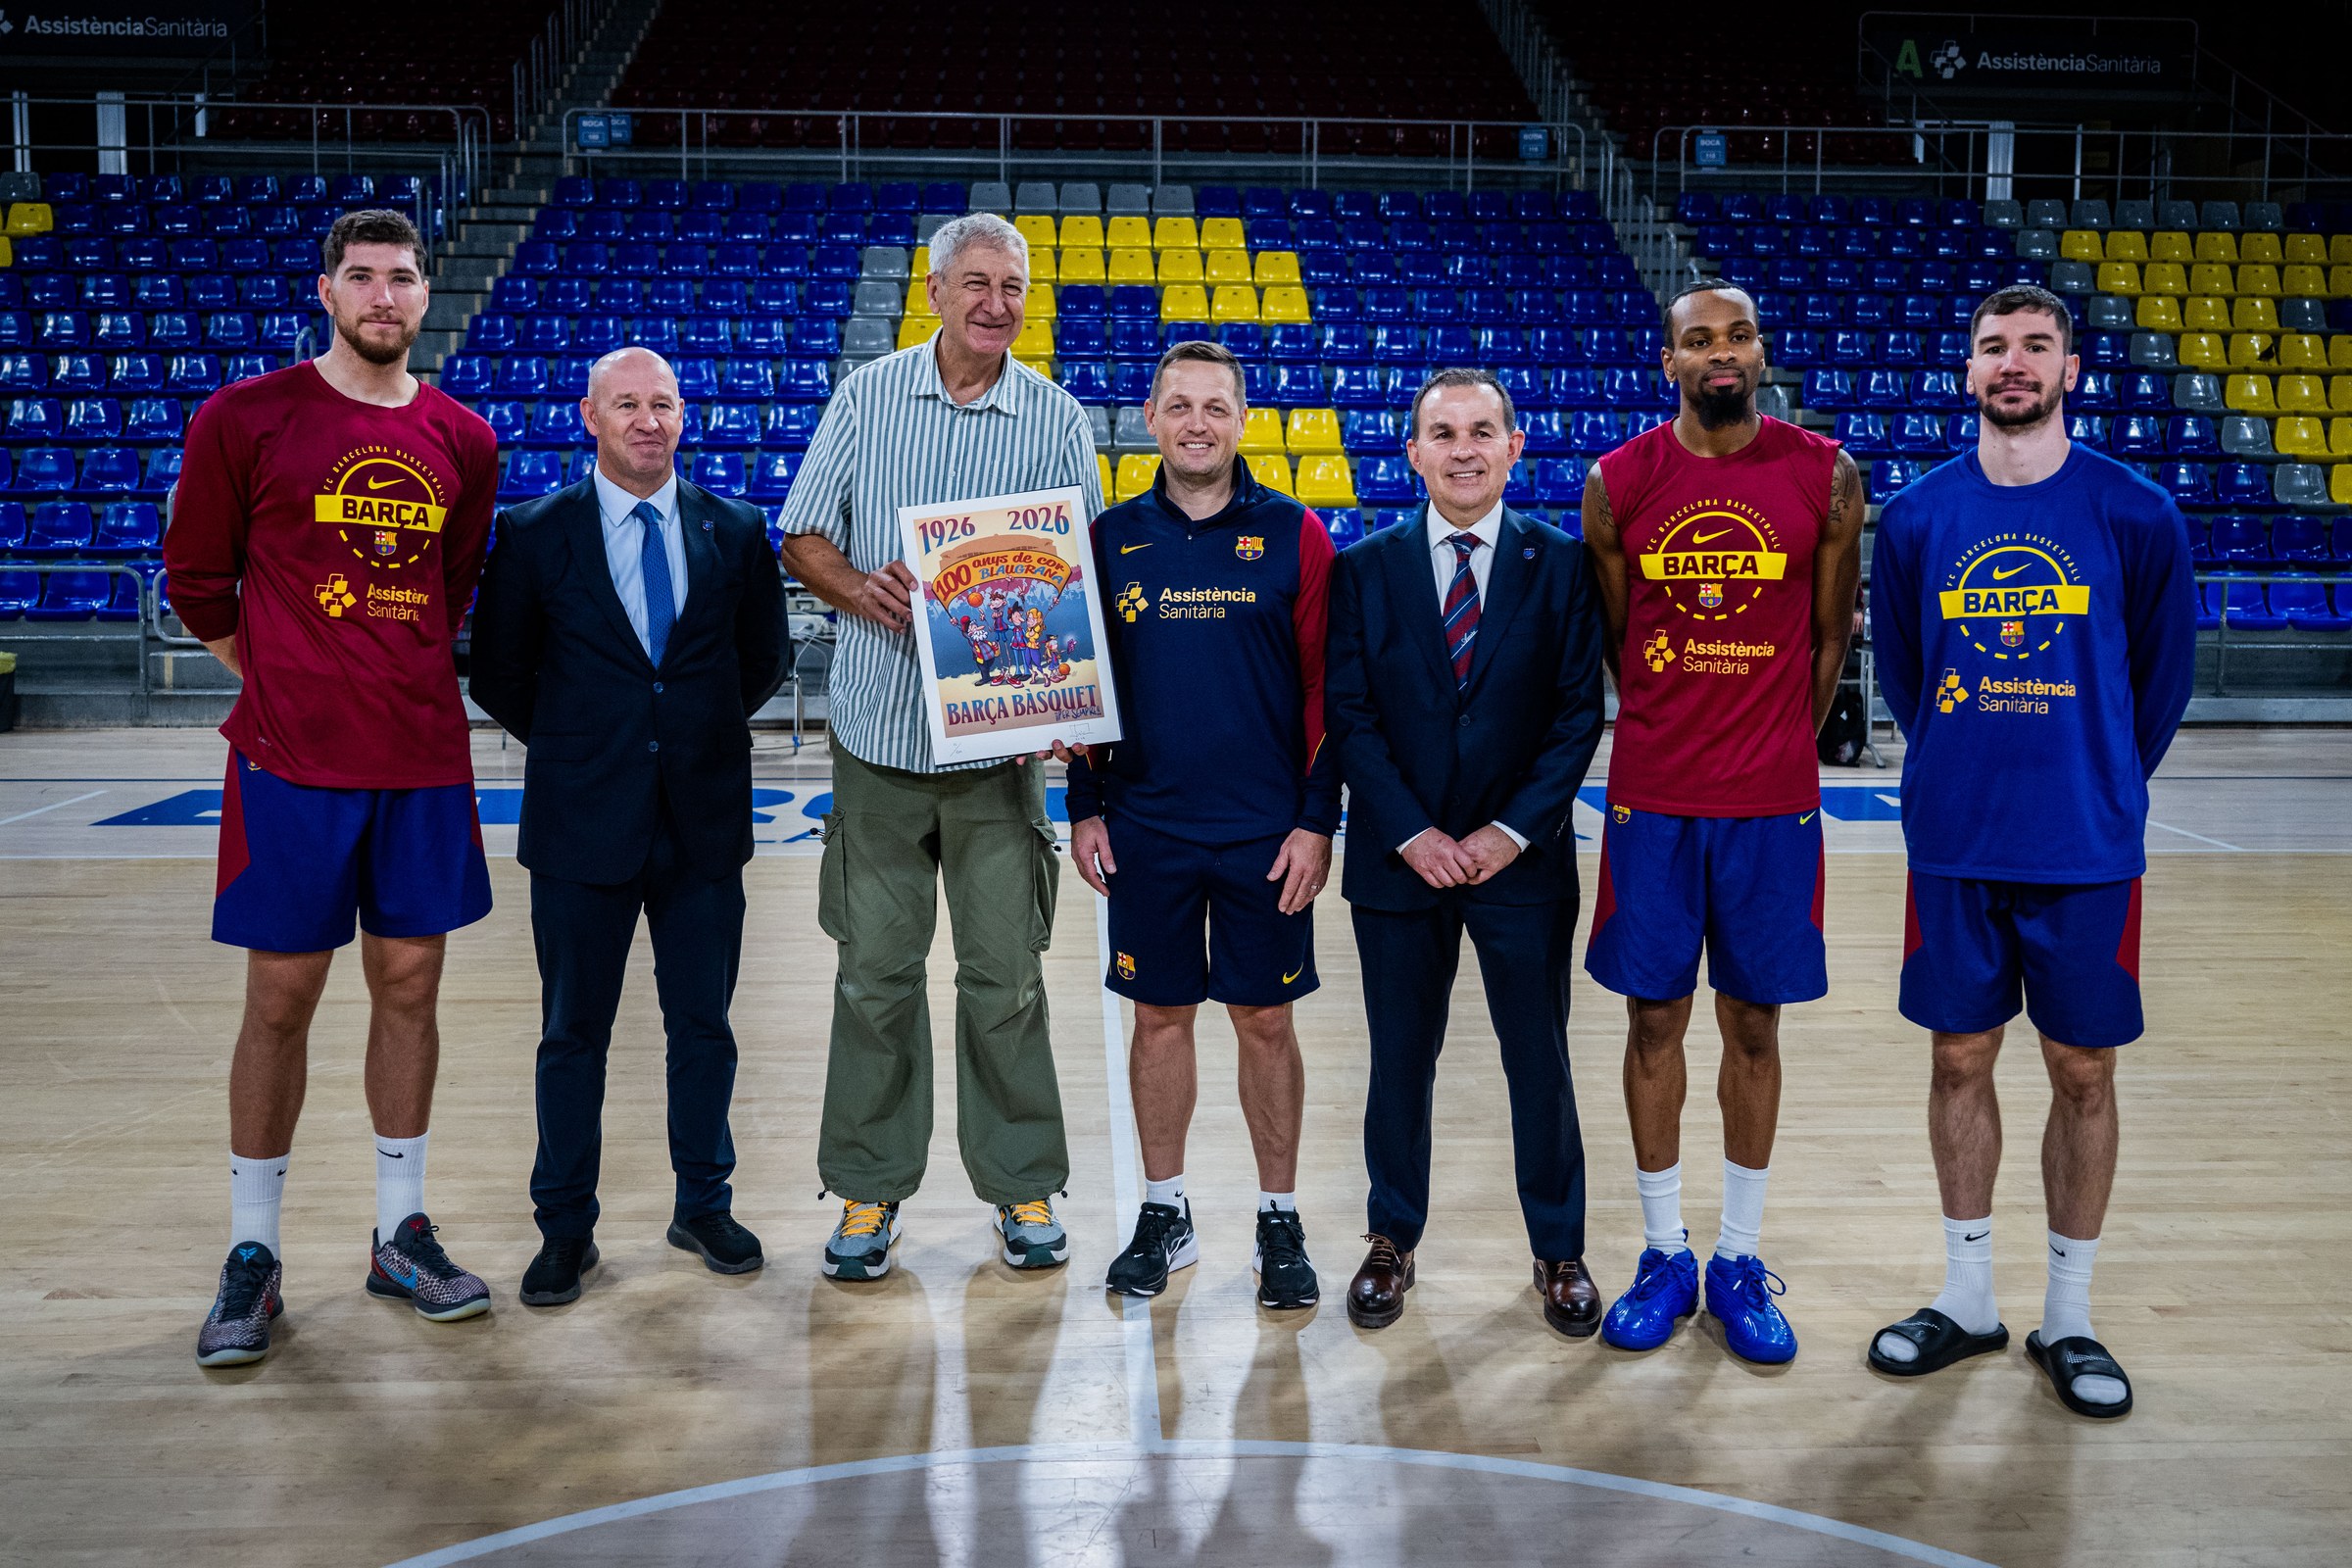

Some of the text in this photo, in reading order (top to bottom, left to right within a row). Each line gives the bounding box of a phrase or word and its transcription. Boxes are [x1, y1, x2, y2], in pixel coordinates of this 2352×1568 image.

[1894, 39, 1923, 77] A
[323, 445, 446, 503] FC BARCELONA BASKETBALL
[342, 499, 429, 529] BARÇA
[1646, 499, 1781, 551] FC BARCELONA BASKETBALL
[918, 505, 1069, 556] 1926 2026
[1663, 555, 1759, 579] BARÇA
[1946, 533, 2081, 587] FC BARCELONA BASKETBALL
[936, 552, 1065, 602] 100 anys de cor
[979, 564, 1063, 585] BLAUGRANA
[1158, 587, 1256, 603] Assistència
[1964, 588, 2060, 615] BARÇA
[1158, 604, 1226, 619] Sanitària
[1684, 638, 1775, 658] Assistència
[1683, 656, 1749, 674] Sanitària
[1979, 675, 2077, 697] Assistència
[946, 685, 1097, 725] BARÇA BÀSQUET
[1978, 694, 2049, 714] Sanitària
